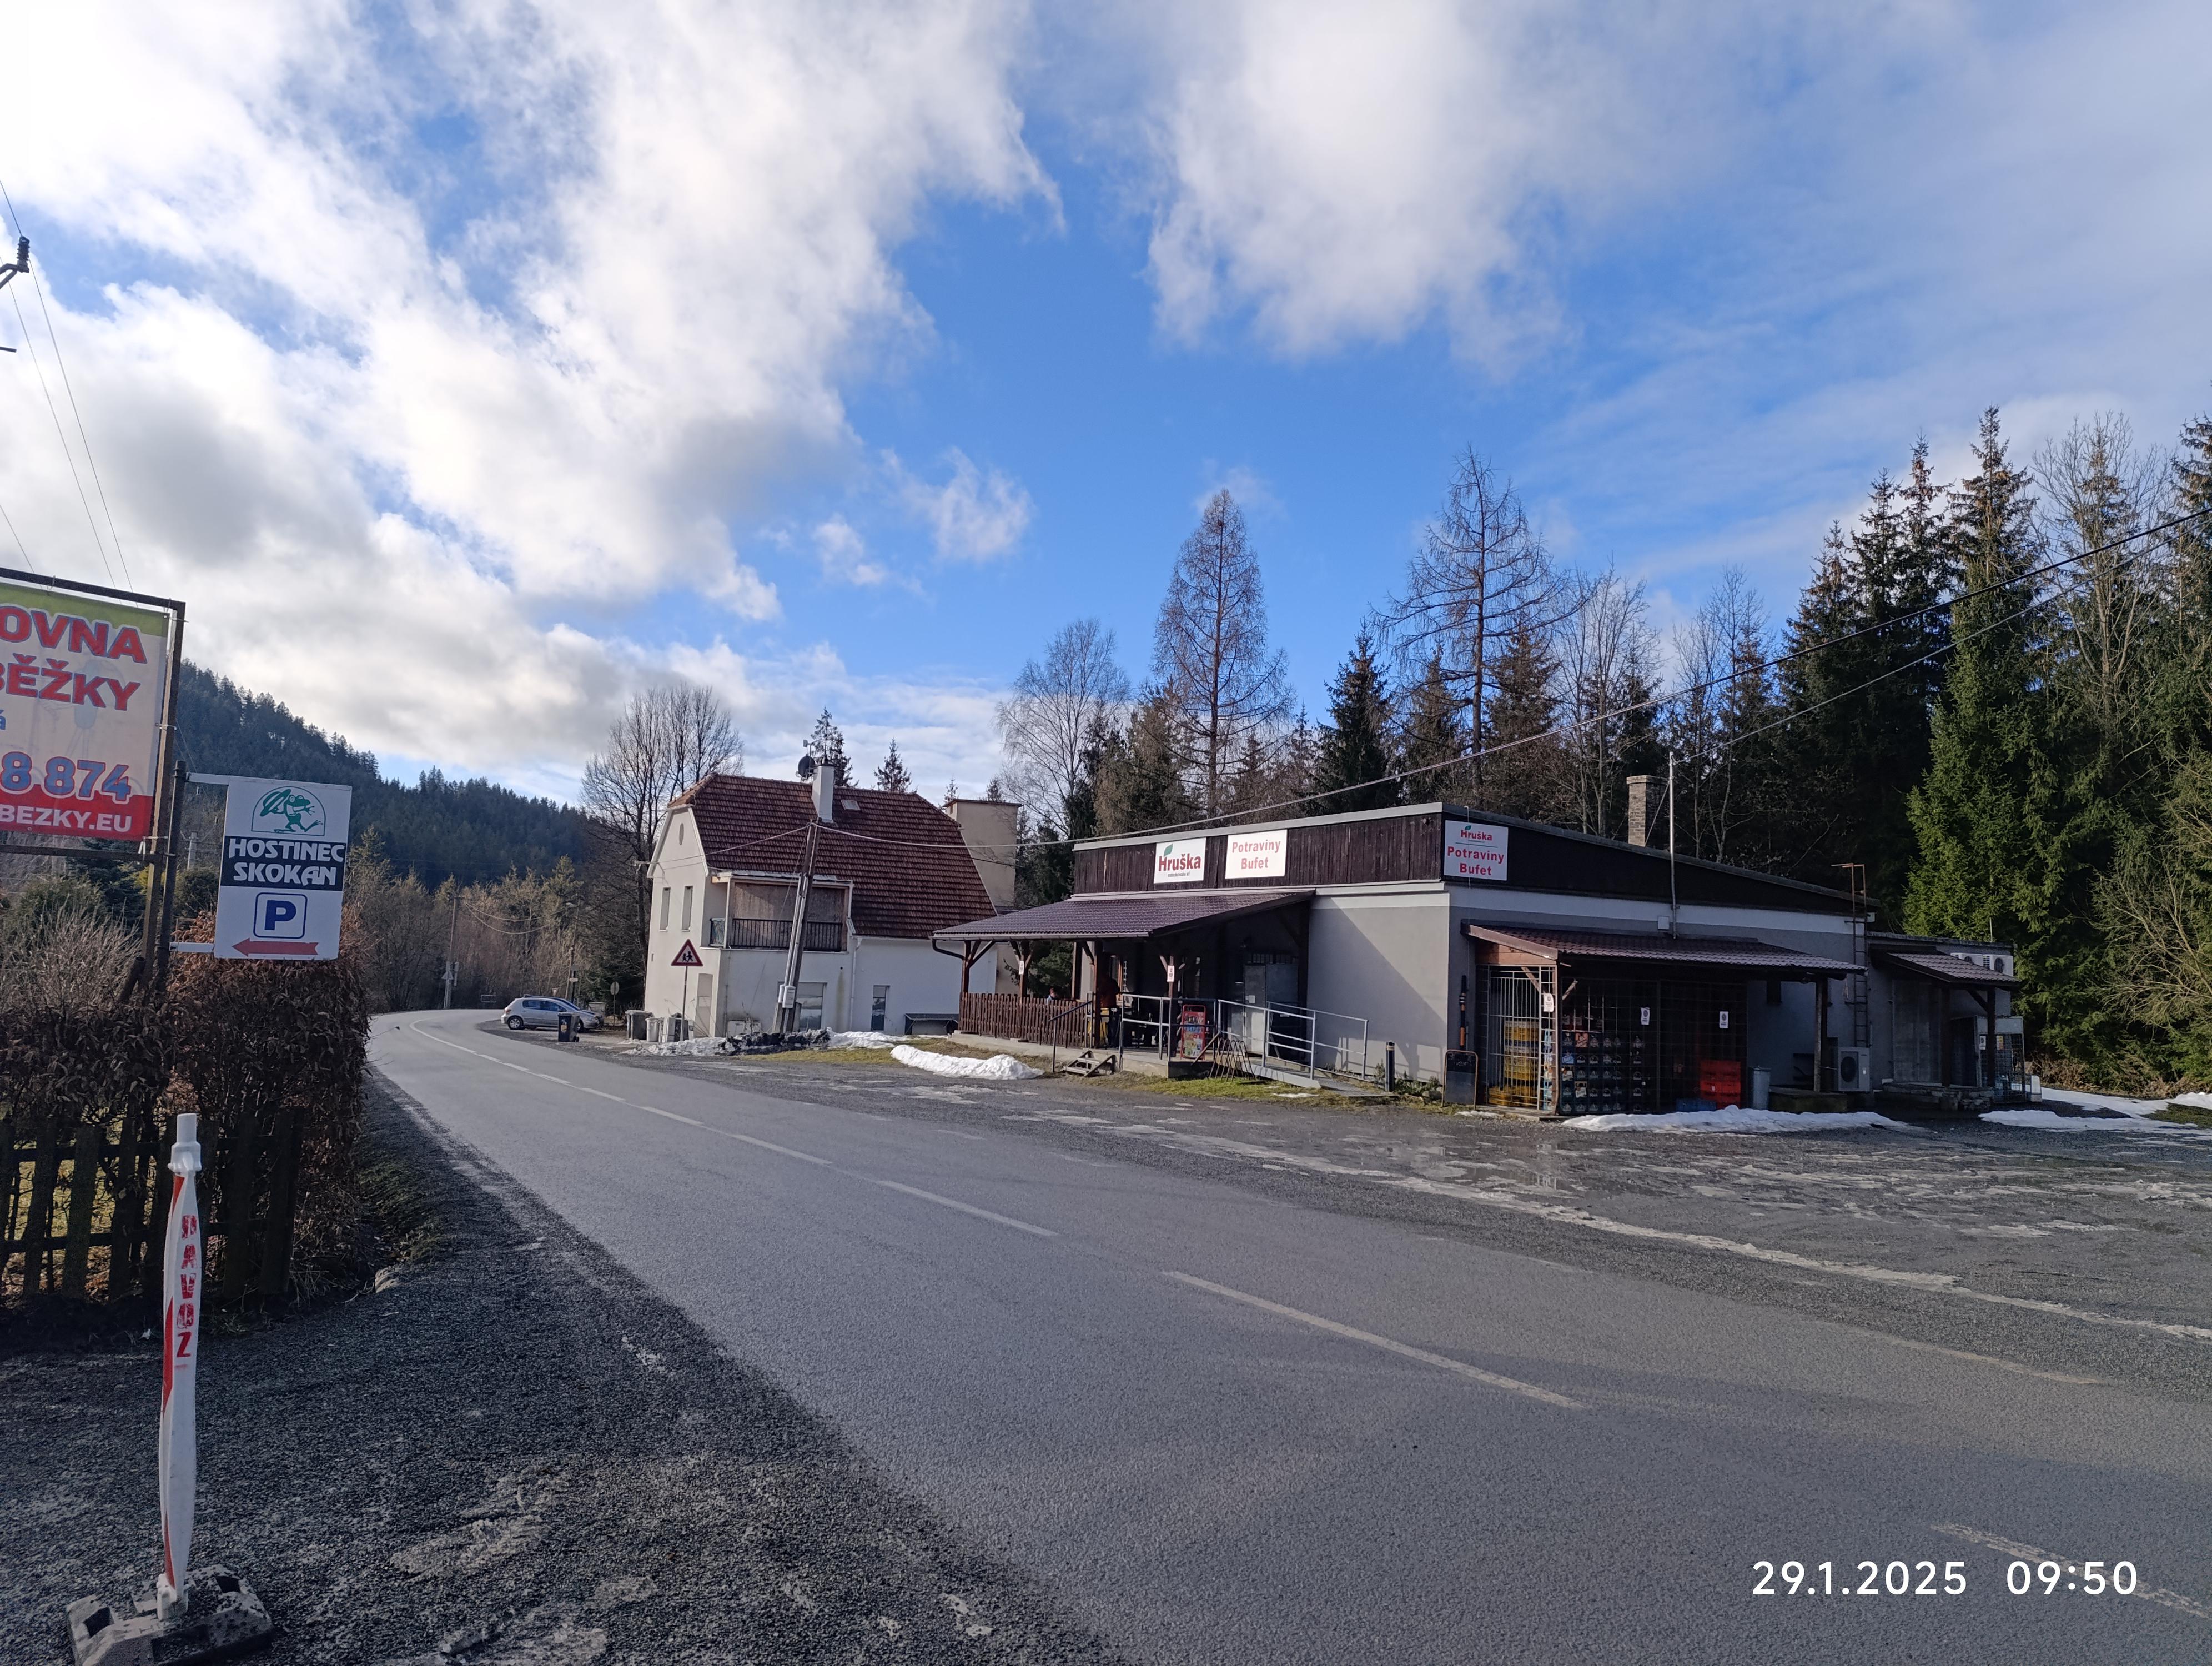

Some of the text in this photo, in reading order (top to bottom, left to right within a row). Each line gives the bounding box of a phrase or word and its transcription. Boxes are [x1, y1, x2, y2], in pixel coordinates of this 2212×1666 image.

[0, 653, 141, 711] ĚŽKY
[44, 756, 132, 802] 874
[1460, 829, 1492, 841] Hruška
[228, 838, 345, 862] HOSTINEC
[1231, 839, 1281, 854] Potraviny
[1447, 846, 1505, 864] Potraviny
[1158, 852, 1201, 871] Hruška
[1241, 857, 1269, 870] Bufet
[1459, 862, 1492, 876] Bufet
[233, 862, 337, 886] SKOKAN
[264, 900, 297, 931] P
